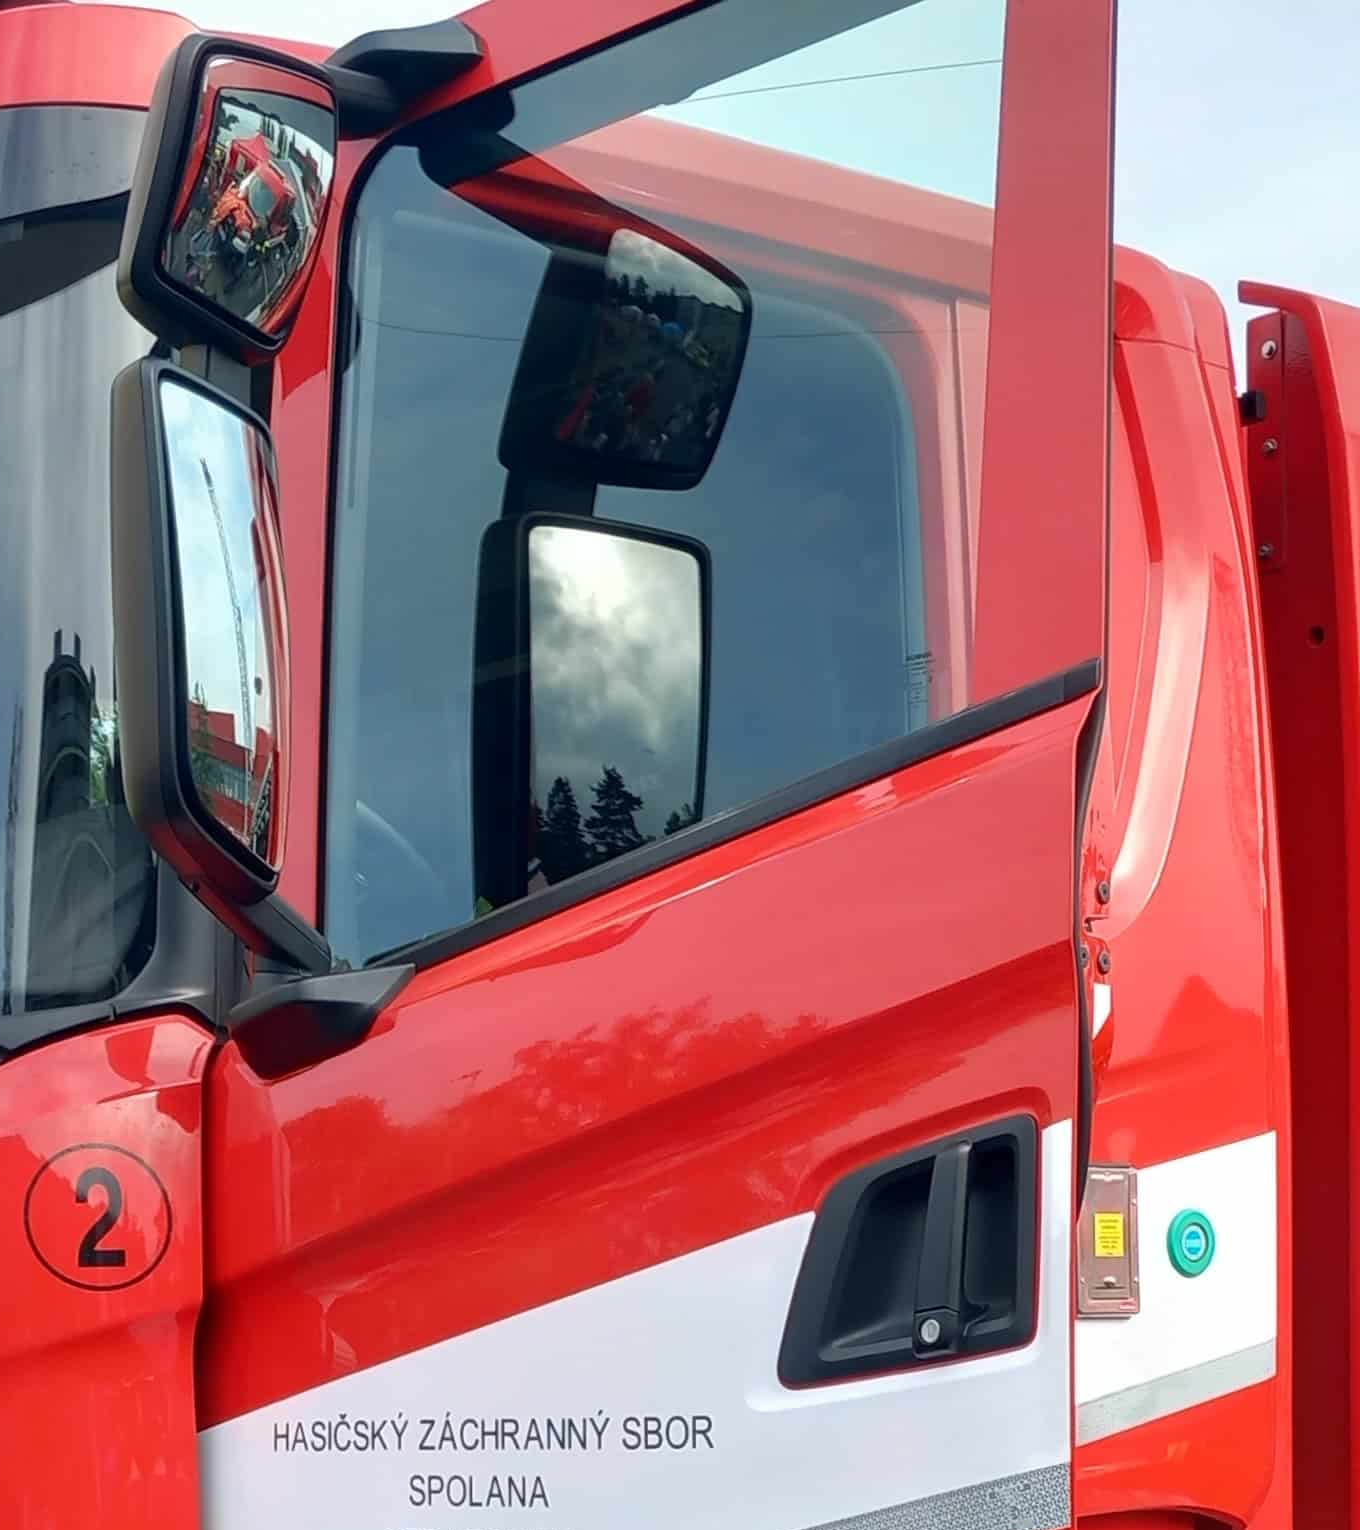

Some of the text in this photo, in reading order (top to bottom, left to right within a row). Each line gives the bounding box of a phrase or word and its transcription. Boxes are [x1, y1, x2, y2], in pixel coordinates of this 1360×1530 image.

[75, 1167, 127, 1268] 2
[272, 1408, 715, 1453] HASIČSKÝ ZÁCHRANNÝ SBOR
[408, 1474, 550, 1509] SPOLANA
